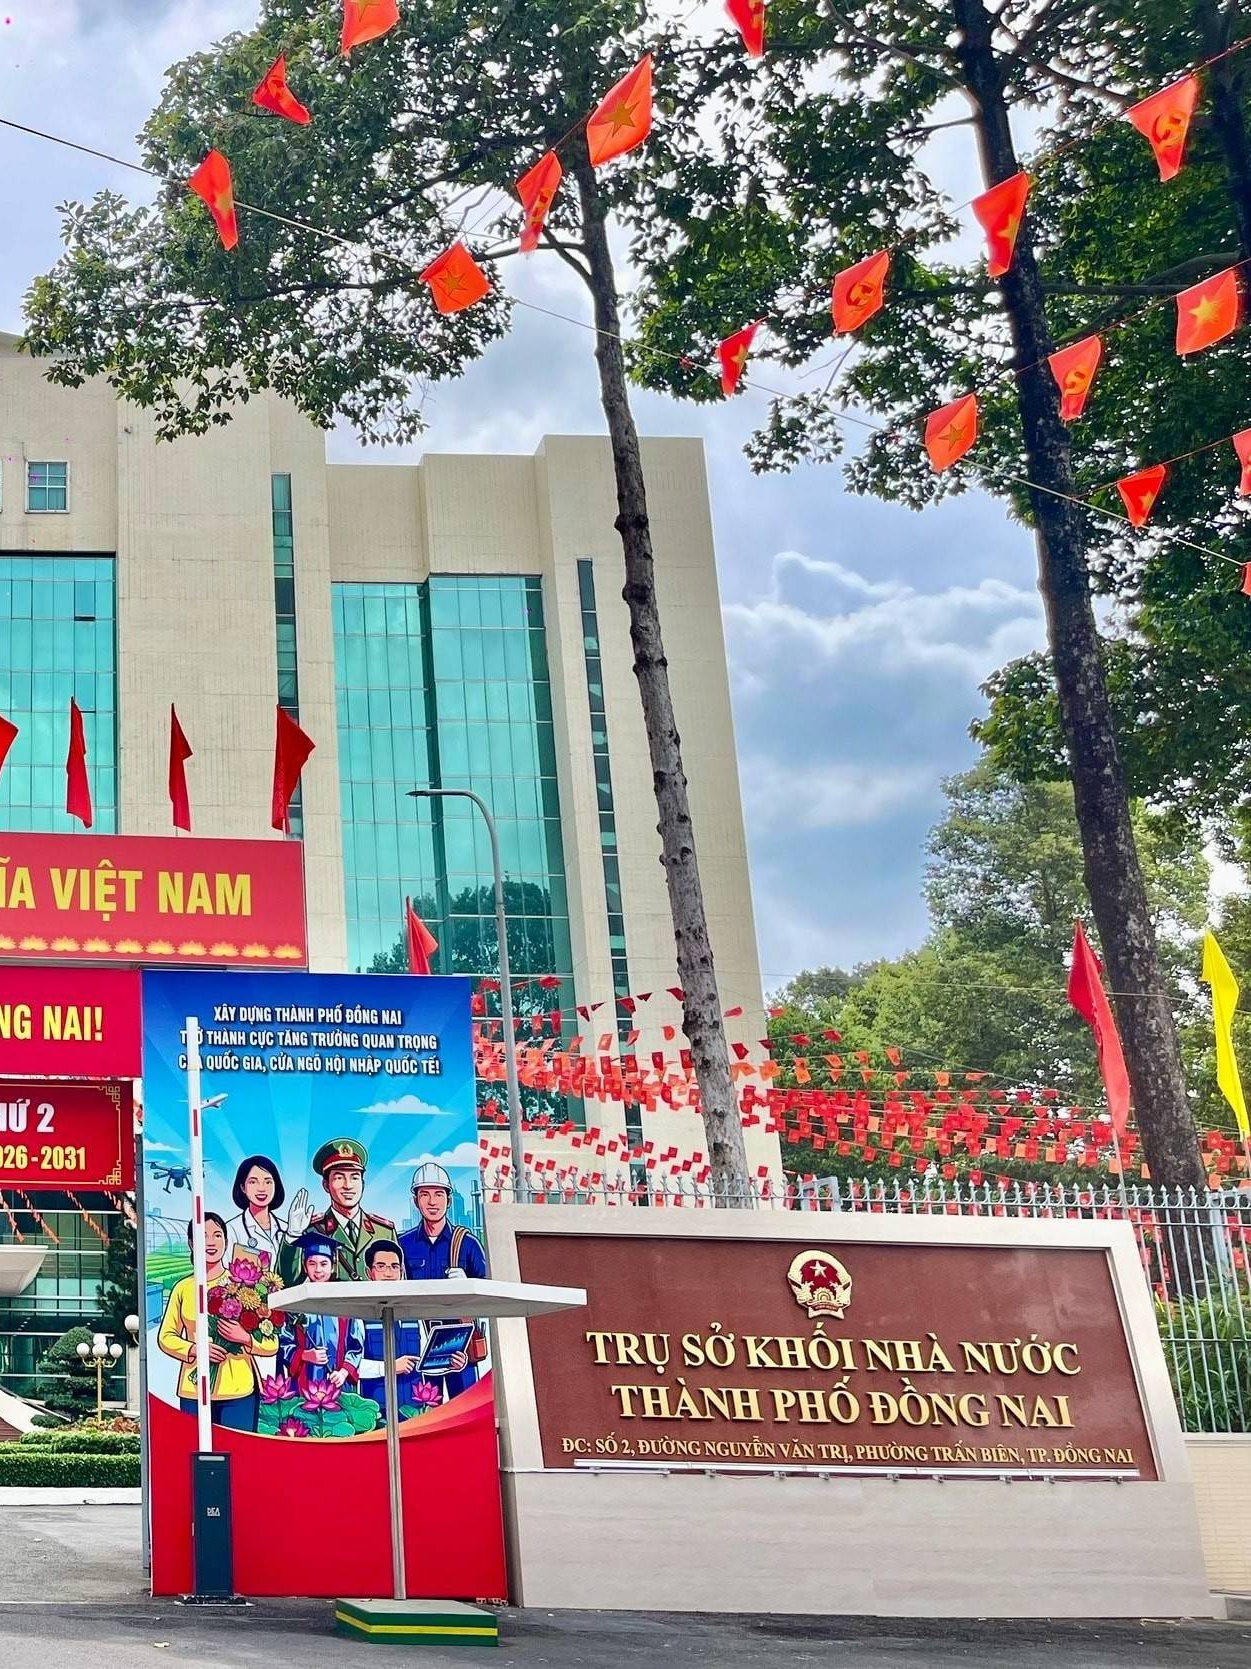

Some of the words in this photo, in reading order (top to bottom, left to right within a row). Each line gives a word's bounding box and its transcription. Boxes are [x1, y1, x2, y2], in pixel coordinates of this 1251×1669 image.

[50, 859, 143, 921] VIỆT
[159, 872, 251, 916] NAM
[44, 1006, 102, 1040] NAI!
[214, 1004, 236, 1021] XÂY
[240, 1006, 271, 1024] DỰNG
[275, 1005, 314, 1022] THÀNH
[318, 1004, 342, 1023] PHỐ
[345, 1005, 378, 1024] ĐỒNG
[382, 1010, 401, 1024] NAI
[180, 1027, 203, 1046] TỞ
[206, 1028, 245, 1045] THÀNH
[250, 1030, 273, 1048] CỰC
[277, 1030, 307, 1045] TĂNG
[311, 1029, 358, 1047] TRƯỞNG
[363, 1034, 394, 1048] QUAN
[397, 1035, 436, 1051] TRỌNG
[207, 1050, 238, 1070] QUỐC
[243, 1056, 266, 1072] GIA,
[270, 1052, 293, 1070] CỬA
[297, 1055, 321, 1071] NGÕ
[326, 1055, 345, 1074] HỘI
[350, 1056, 381, 1075] NHẬP
[385, 1055, 417, 1074] QUỐC
[421, 1056, 439, 1073] TẾ!
[37, 1104, 54, 1132] 2
[586, 1332, 670, 1373] TRỤ
[682, 1322, 735, 1366] SỞ
[743, 1322, 856, 1370] KHỐI
[861, 1332, 956, 1373] NHÀ
[960, 1334, 1081, 1374] NƯỚC
[612, 1377, 764, 1420] THÀNH
[769, 1376, 859, 1423] PHỐ
[867, 1377, 991, 1427] ĐỒNG
[997, 1394, 1075, 1428] NAI
[562, 1438, 591, 1452] ĐC:
[595, 1432, 617, 1454] SỐ
[622, 1440, 635, 1456] 2,
[637, 1436, 700, 1455] ĐƯỜNG
[704, 1436, 776, 1457] NGUYỄN
[778, 1439, 814, 1459] VĂN
[818, 1444, 853, 1463] TRỊ,
[855, 1441, 928, 1461] PHƯỜNG
[931, 1439, 977, 1462] TRẤN
[980, 1444, 1025, 1465] BIÊN,
[1026, 1448, 1052, 1464] TP.
[1054, 1442, 1100, 1464] ĐỒNG
[1103, 1448, 1135, 1463] NAI
